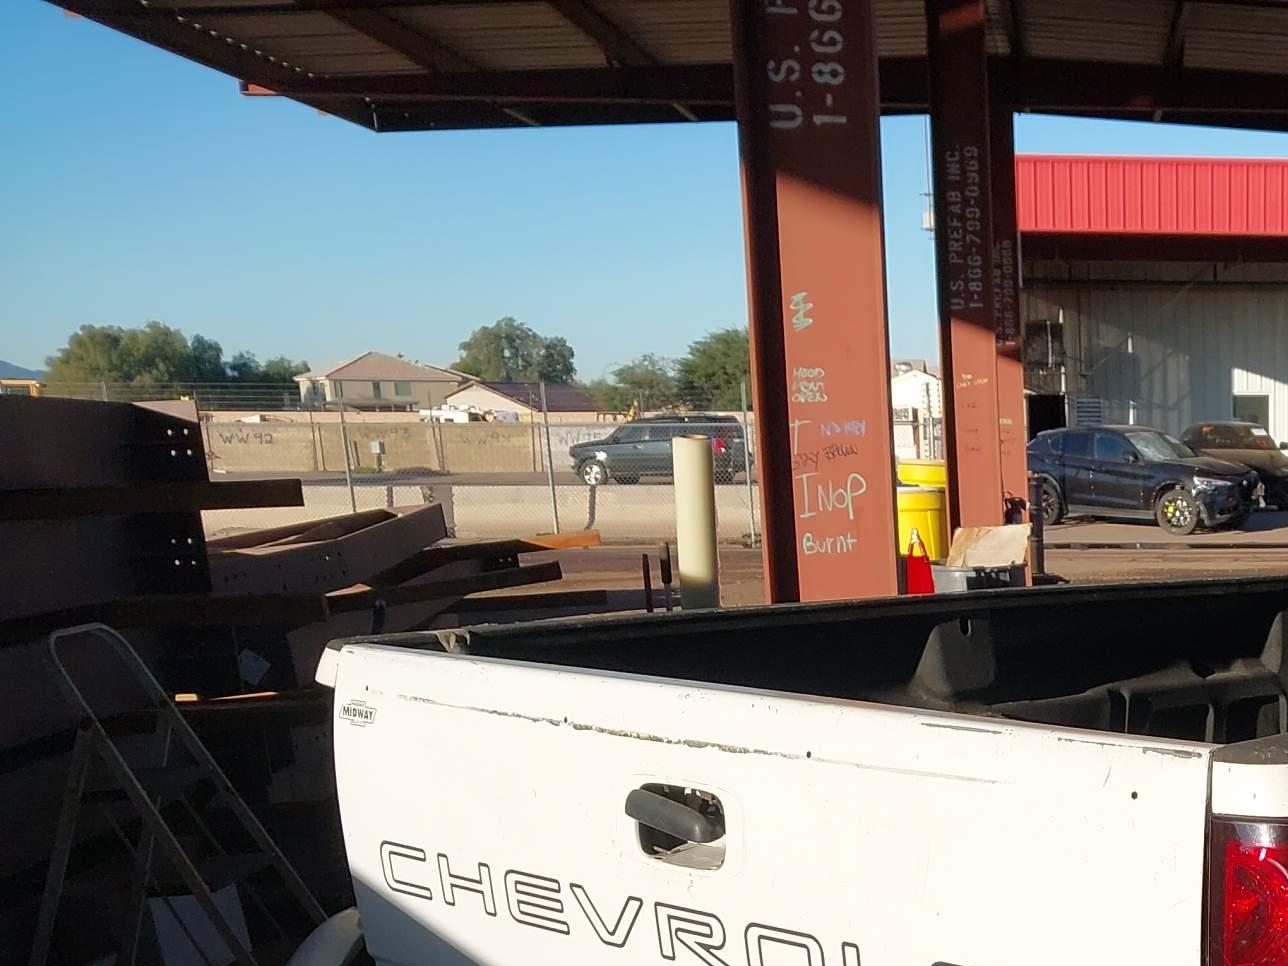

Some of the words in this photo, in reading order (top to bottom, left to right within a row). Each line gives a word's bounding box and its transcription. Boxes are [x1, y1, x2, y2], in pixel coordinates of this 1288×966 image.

[767, 46, 804, 129] U.S.
[945, 144, 961, 181] INC.
[947, 191, 964, 264] PREFAB
[949, 273, 965, 310] U.S.
[339, 702, 374, 721] MIDWAY
